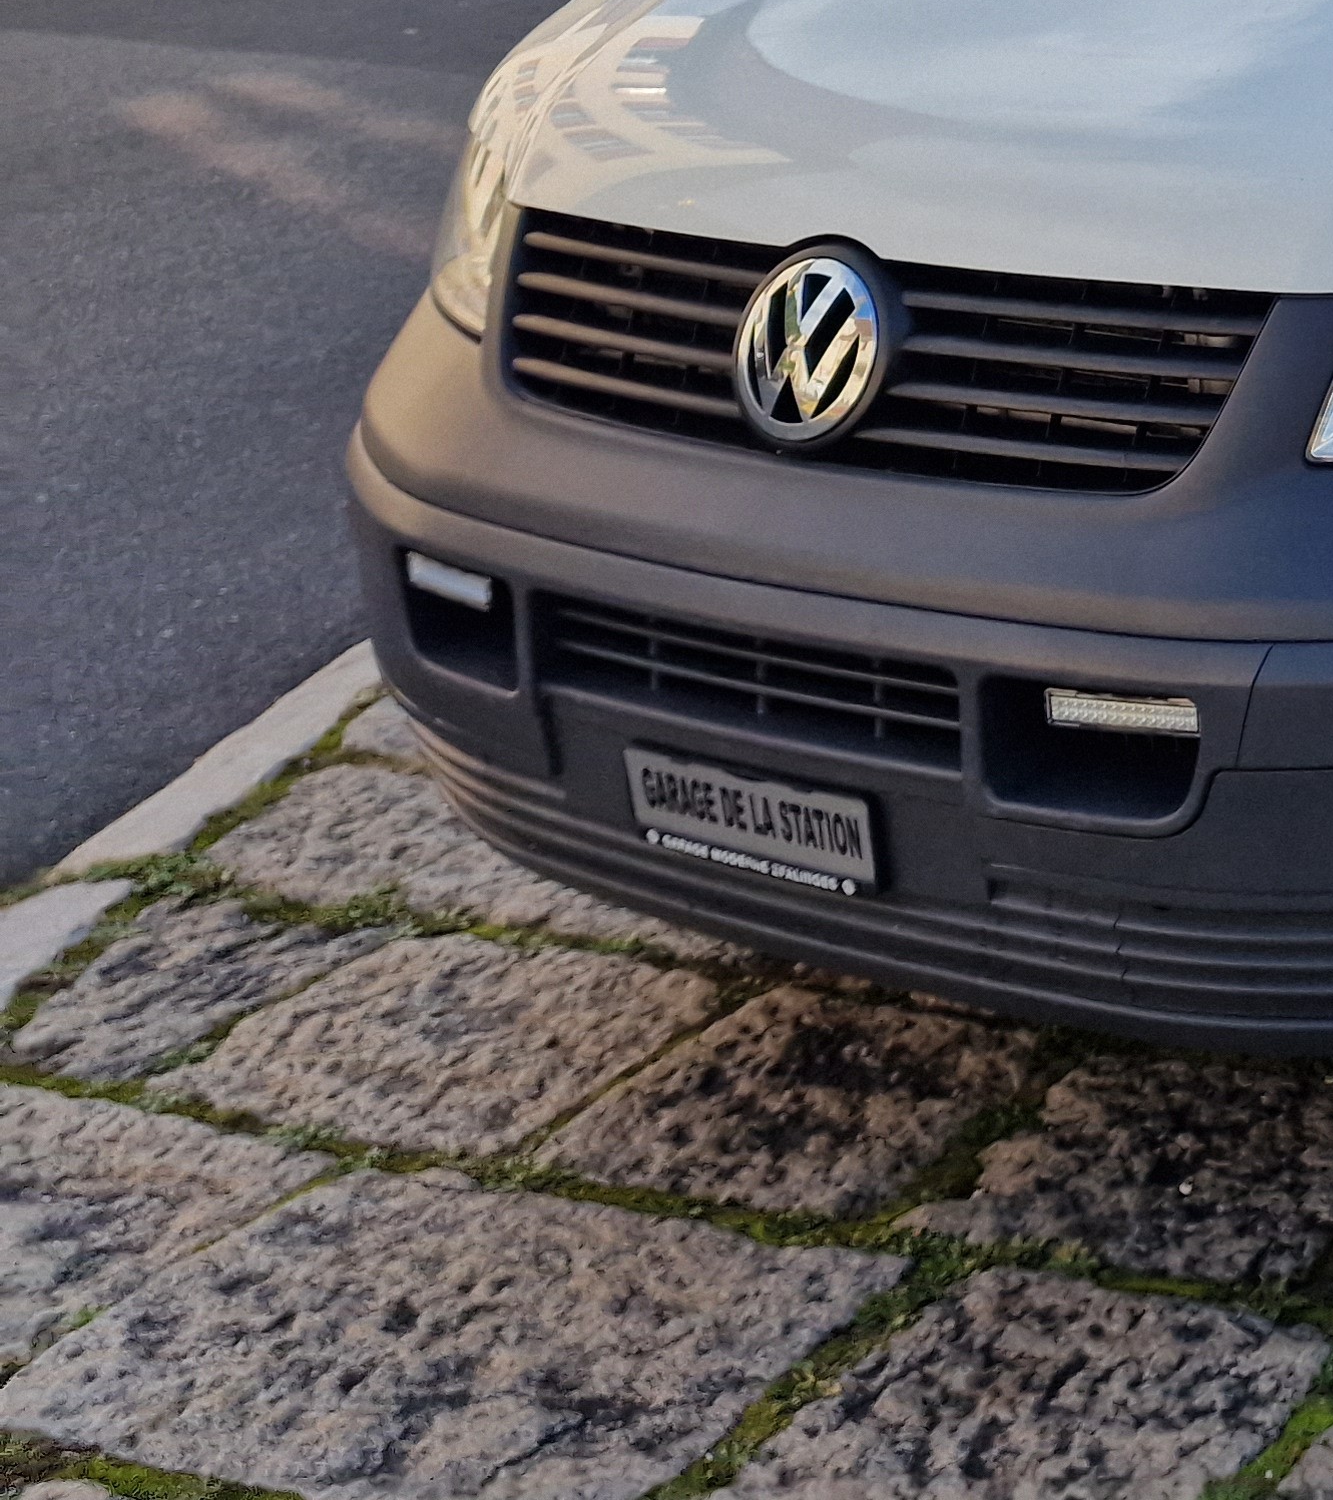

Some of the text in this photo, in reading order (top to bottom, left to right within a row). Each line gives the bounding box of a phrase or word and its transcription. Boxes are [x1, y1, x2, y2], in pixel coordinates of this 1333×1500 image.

[641, 767, 863, 861] GARAGE DE LA STATION
